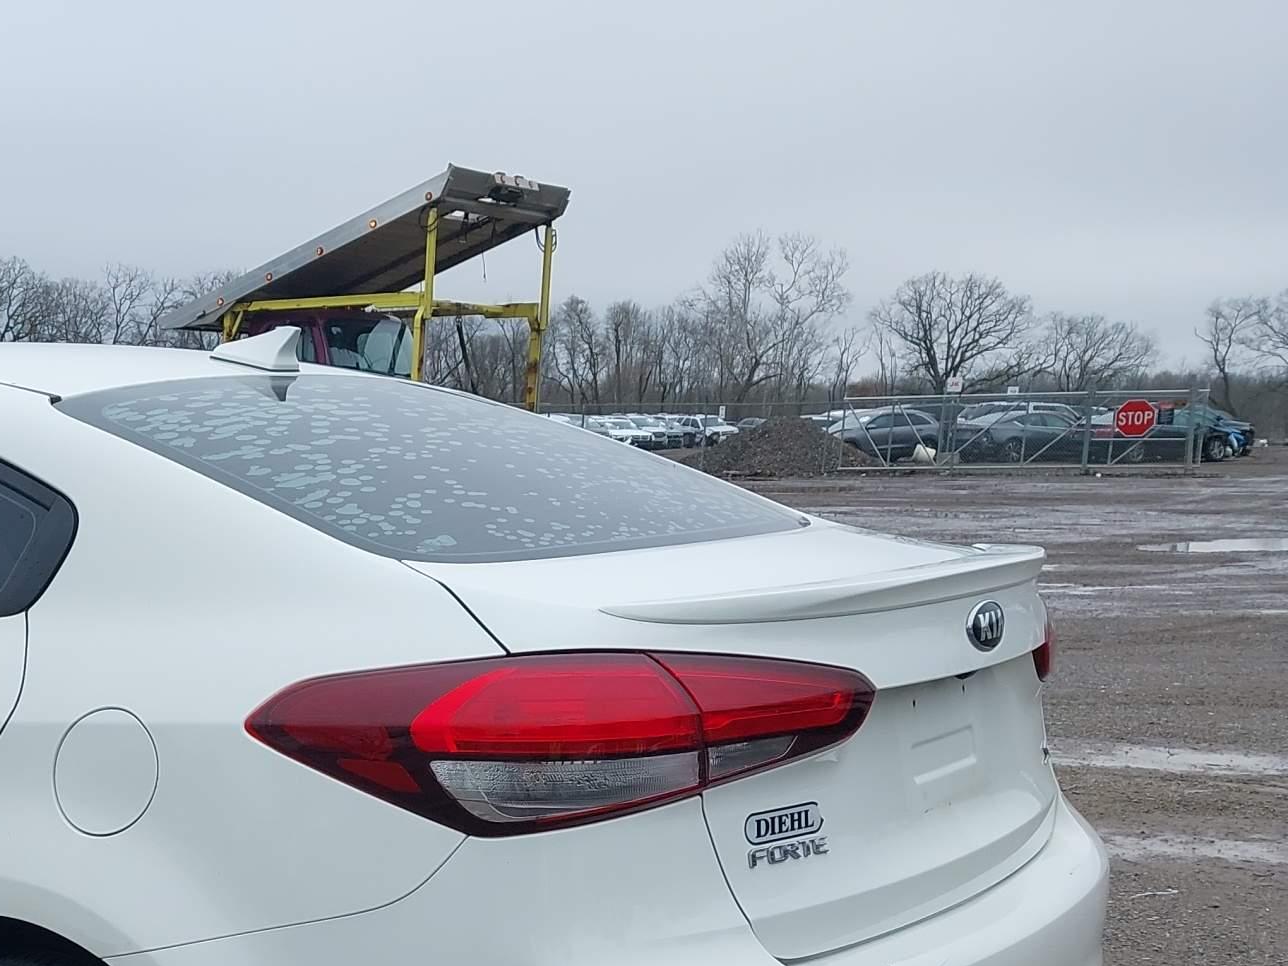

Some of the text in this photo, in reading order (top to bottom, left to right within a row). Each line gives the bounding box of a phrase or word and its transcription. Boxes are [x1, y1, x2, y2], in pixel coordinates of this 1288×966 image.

[1118, 411, 1153, 426] STOP
[754, 809, 815, 839] DIEHL
[747, 836, 830, 869] FORTE
